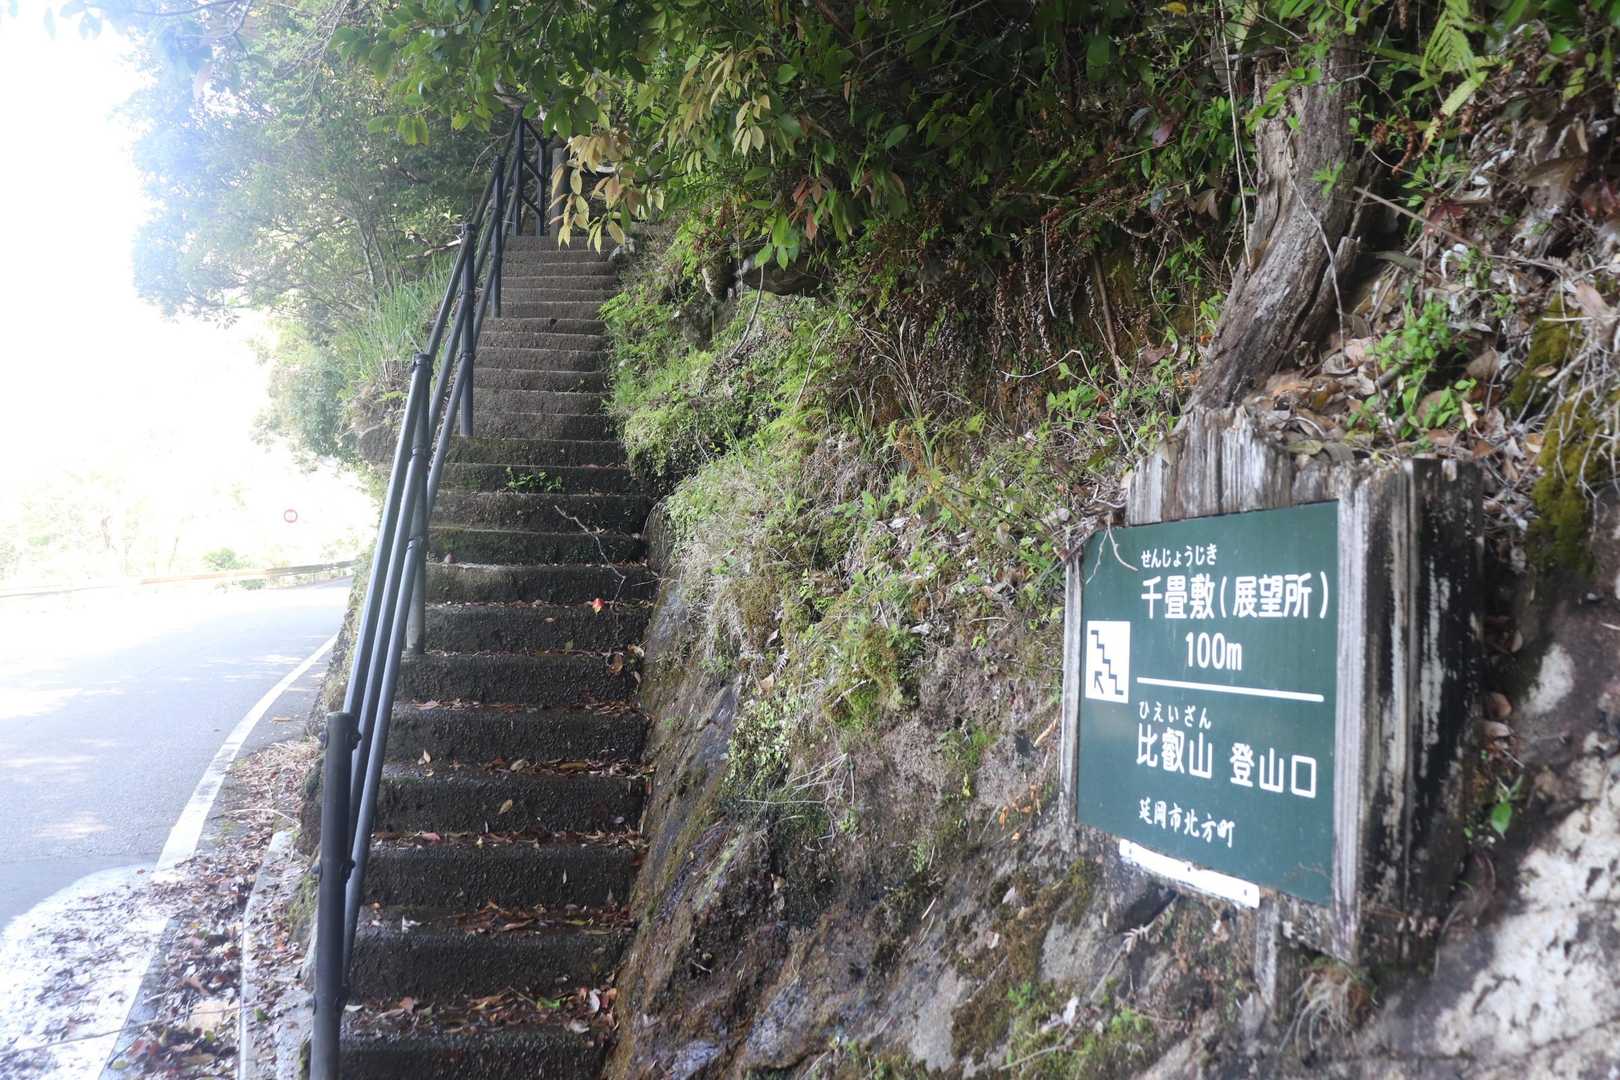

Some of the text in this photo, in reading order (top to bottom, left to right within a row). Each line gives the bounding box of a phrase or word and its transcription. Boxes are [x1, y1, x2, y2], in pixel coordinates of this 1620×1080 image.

[1185, 632, 1243, 671] 100m
[1138, 700, 1212, 730] ひえいざん
[1136, 722, 1318, 799] 比叡山 登山口
[1138, 796, 1236, 848] 延岡市北方町
